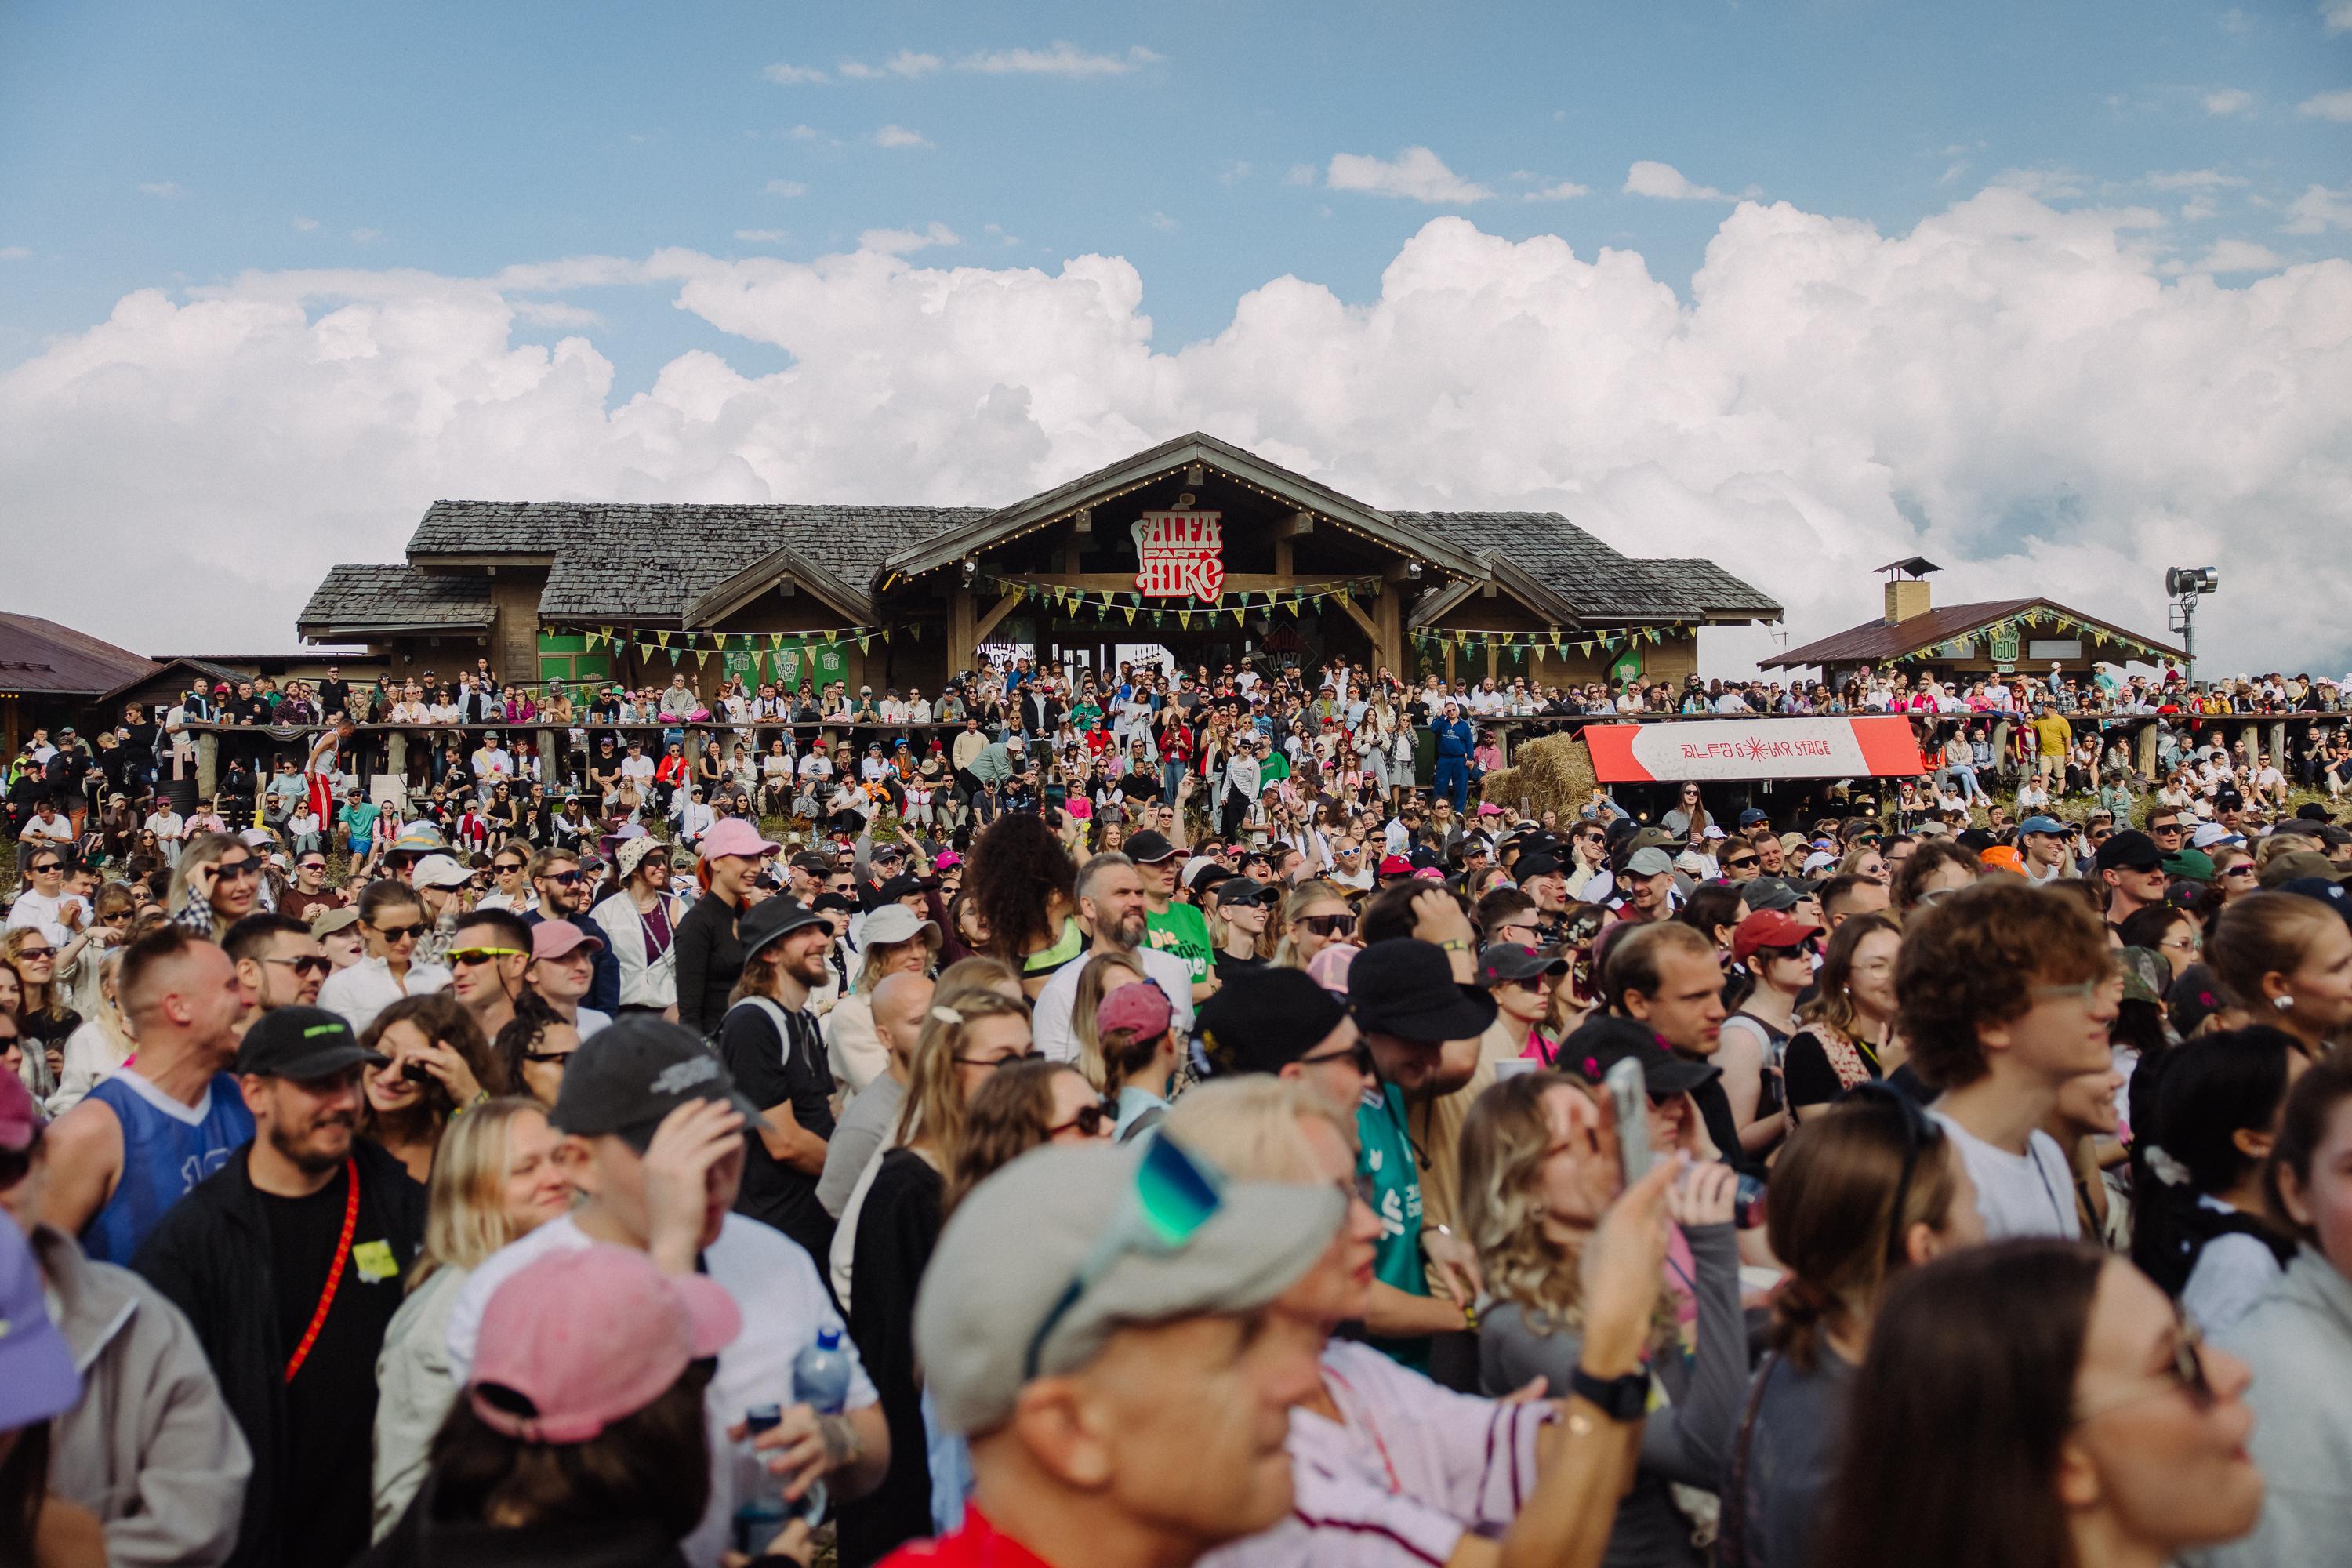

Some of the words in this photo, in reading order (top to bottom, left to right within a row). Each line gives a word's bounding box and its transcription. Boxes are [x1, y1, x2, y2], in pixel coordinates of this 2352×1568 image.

[1142, 511, 1222, 549] ALFA
[1143, 549, 1221, 558] PARTY
[1993, 641, 2016, 659] 1600
[776, 663, 797, 673] ПАСТА
[824, 659, 838, 669] 1600
[1794, 740, 1831, 756] STAGE
